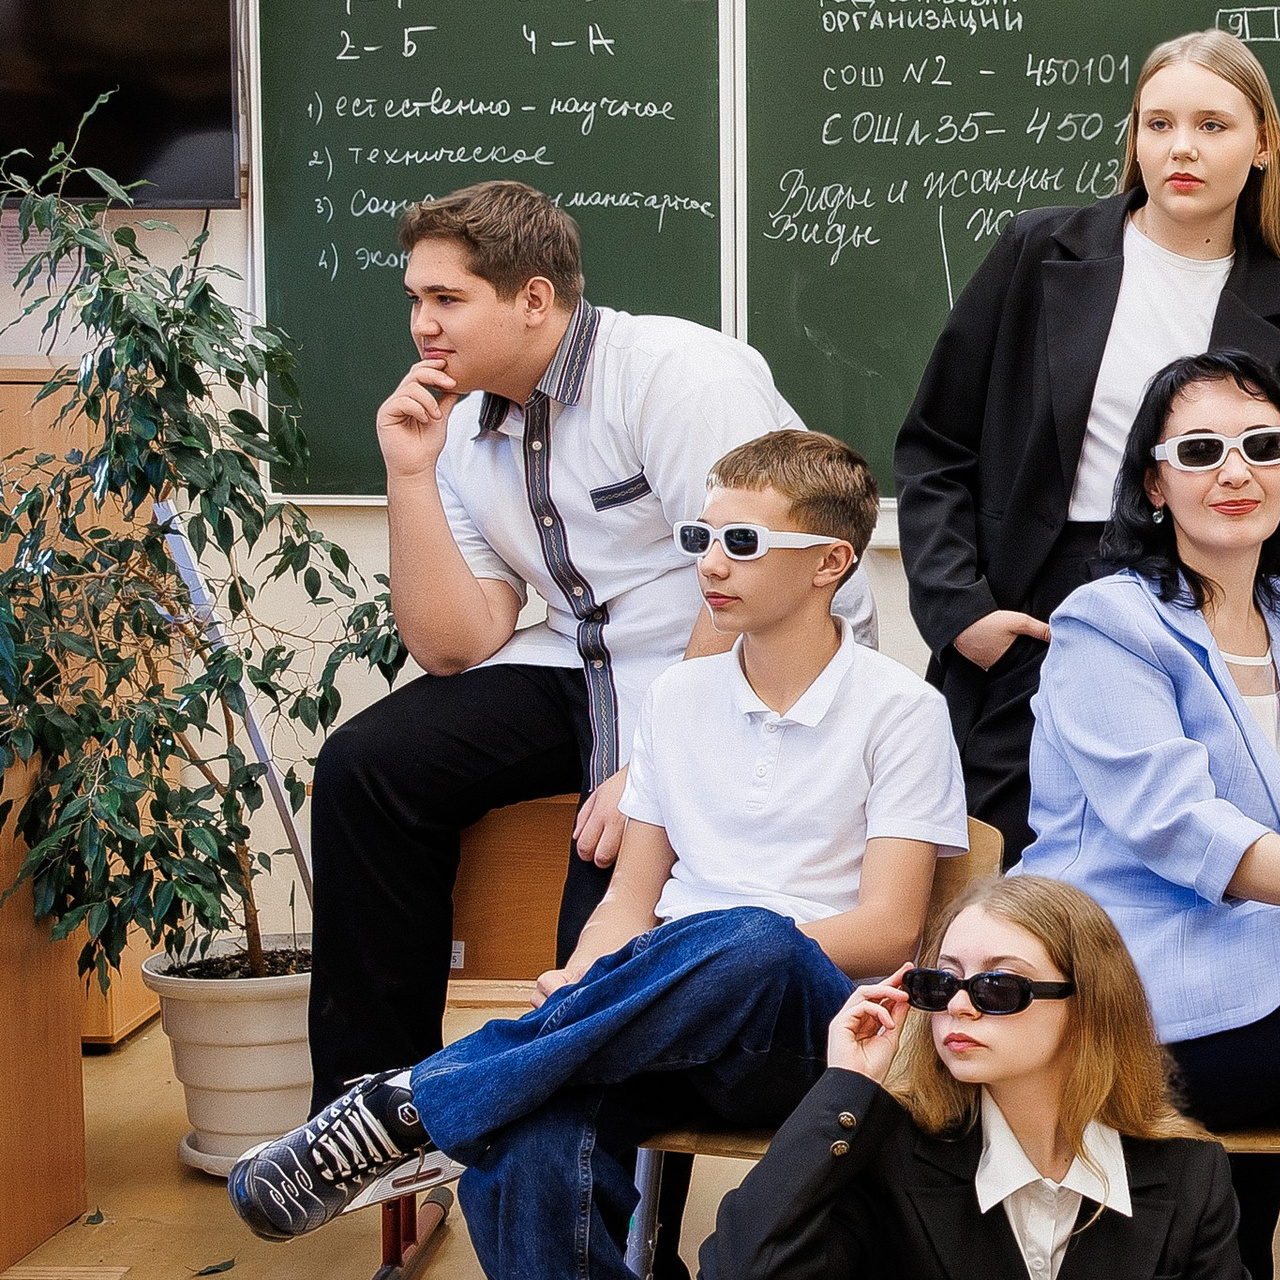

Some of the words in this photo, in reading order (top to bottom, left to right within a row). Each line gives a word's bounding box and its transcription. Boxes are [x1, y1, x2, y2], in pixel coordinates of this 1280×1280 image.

[822, 9, 1023, 36] ОРГАНИЗАЦИИ
[1026, 53, 1131, 88] 450101
[349, 145, 555, 167] техническое
[768, 167, 876, 230] Виды
[887, 179, 908, 203] и
[763, 212, 880, 266] Виды
